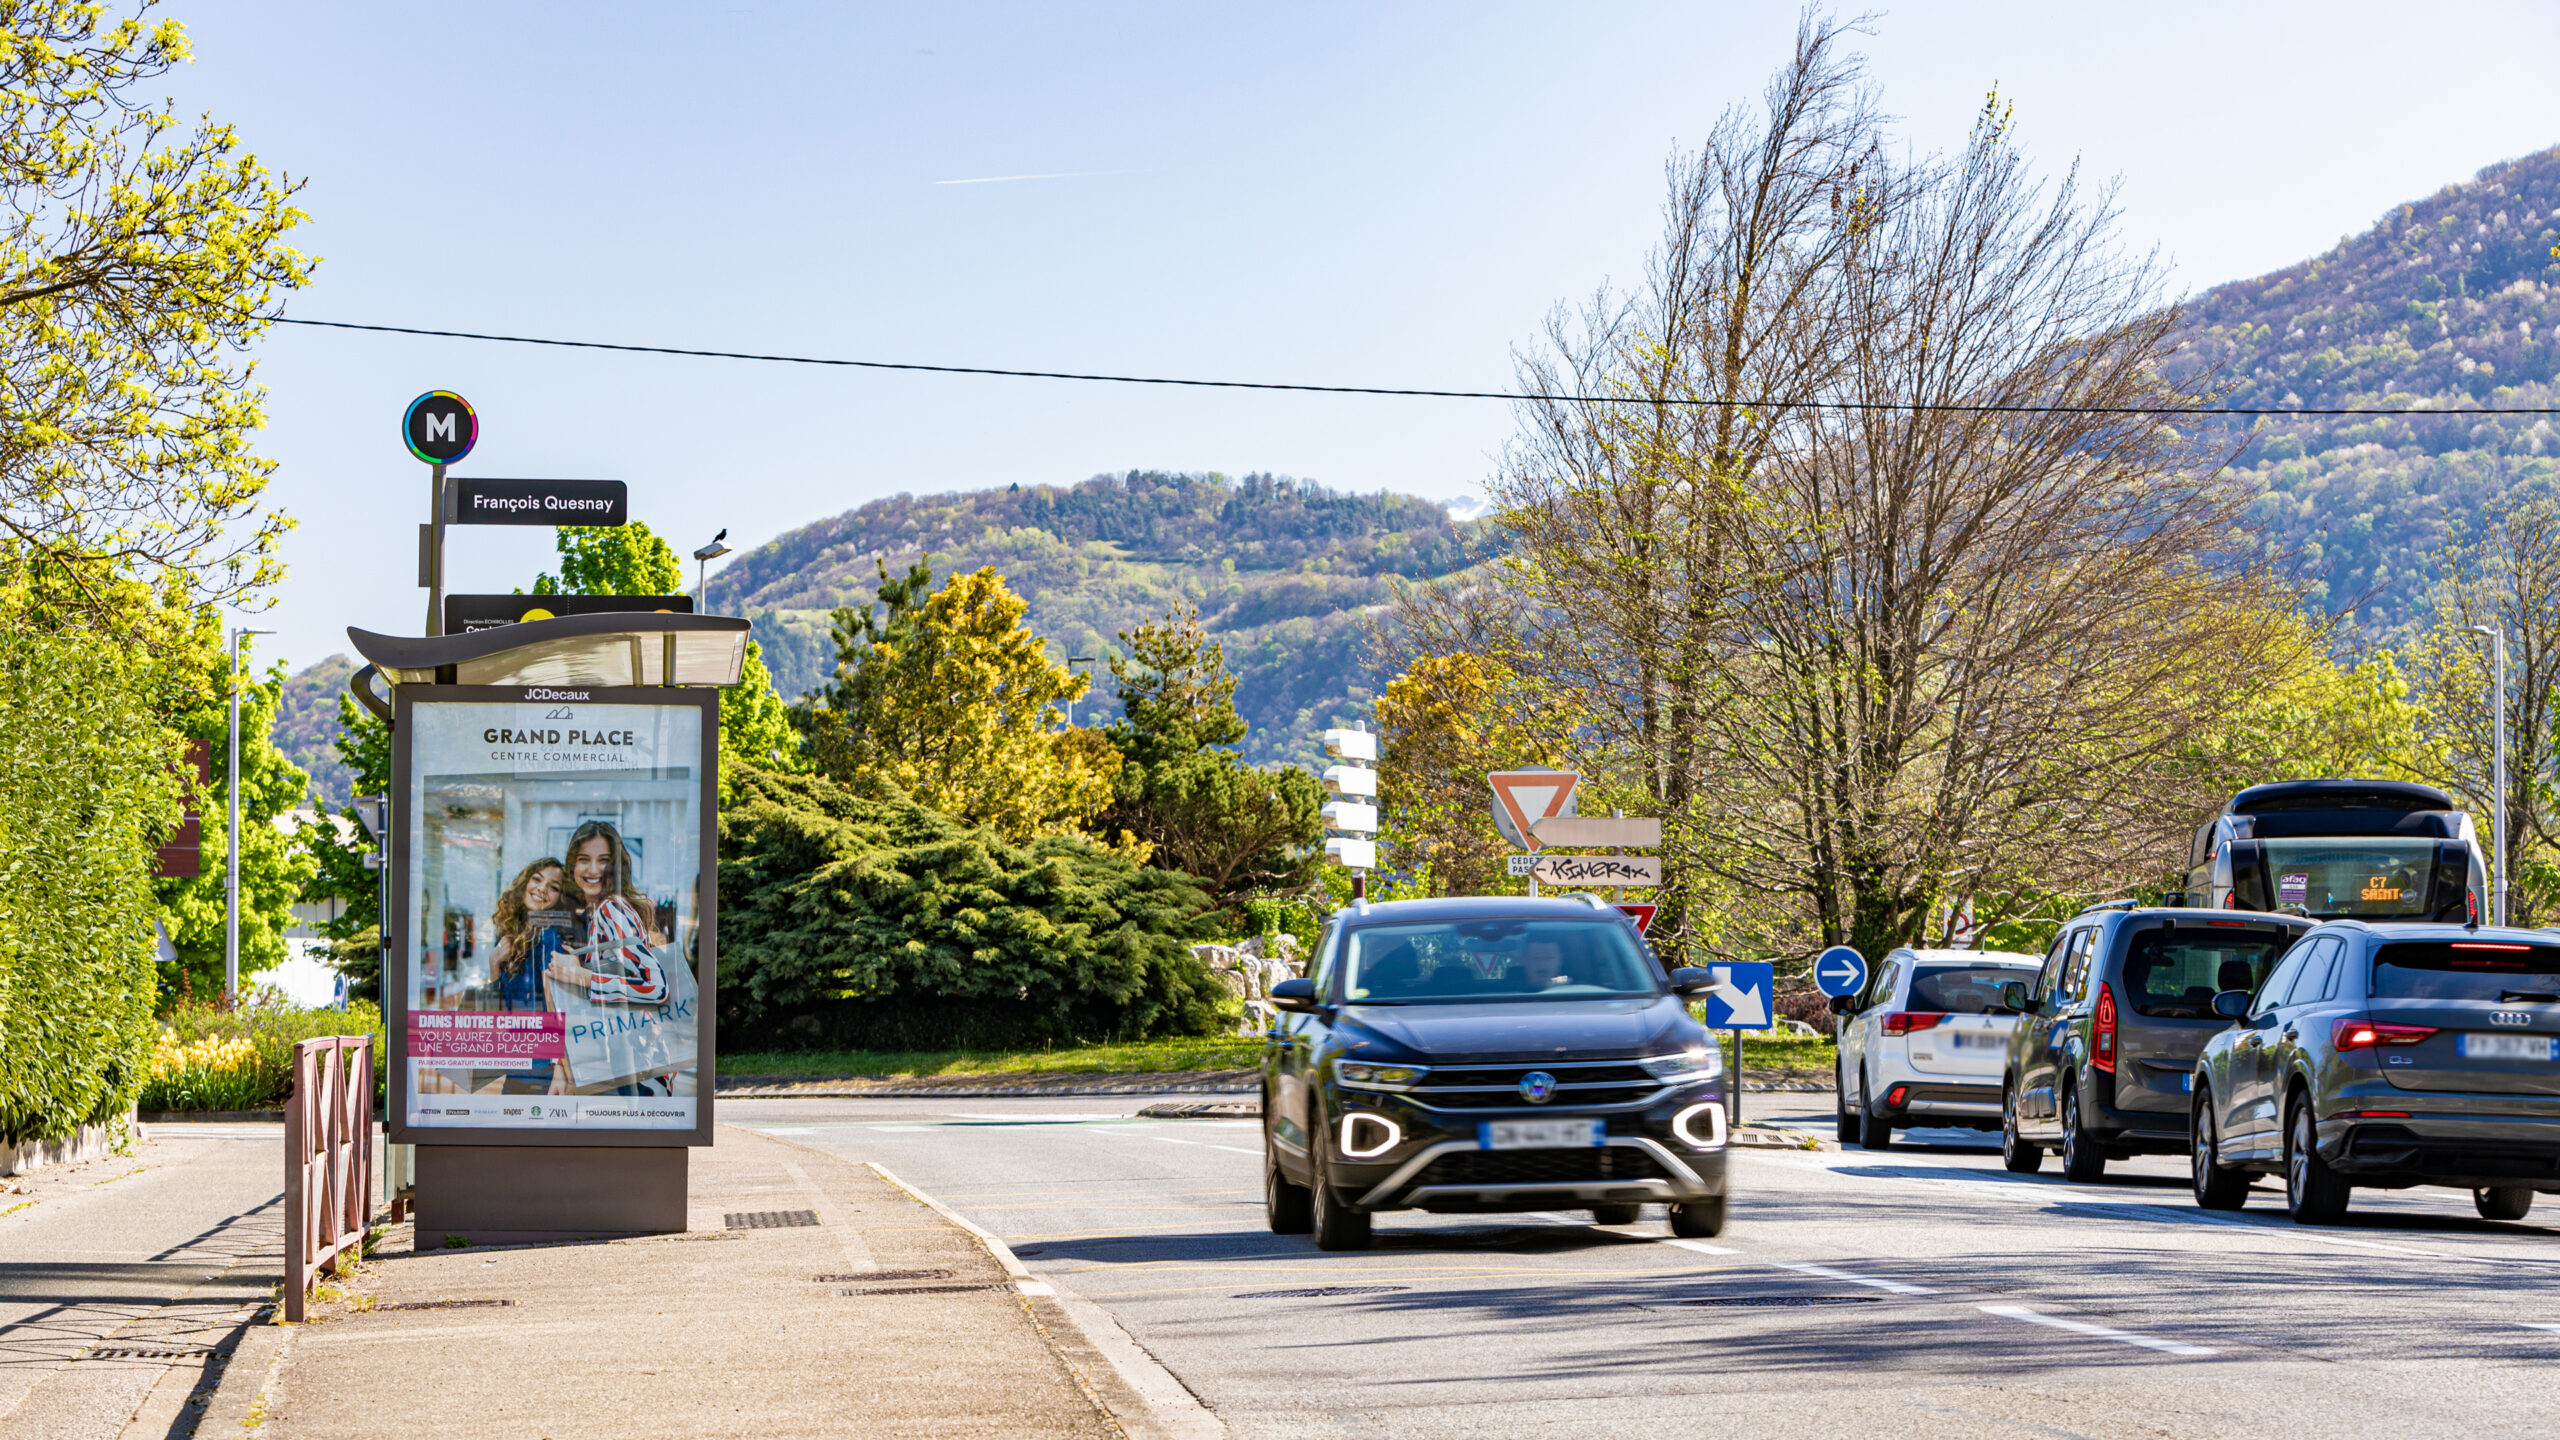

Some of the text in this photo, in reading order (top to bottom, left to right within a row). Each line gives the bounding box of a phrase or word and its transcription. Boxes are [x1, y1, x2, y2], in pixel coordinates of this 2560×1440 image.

[426, 412, 456, 442] M
[473, 494, 614, 513] François Quesnay
[524, 688, 590, 701] JCDecaux
[483, 728, 634, 746] GRAND PLACE
[491, 751, 625, 763] CENTRE COMMERCIAL
[2370, 876, 2387, 888] C7
[418, 1015, 543, 1030] DANS NOTRE CENTRE
[571, 999, 692, 1043] PRIMARK
[418, 1031, 560, 1043] VOUS AUREZ TOUJOURS
[418, 1043, 443, 1053] UNE
